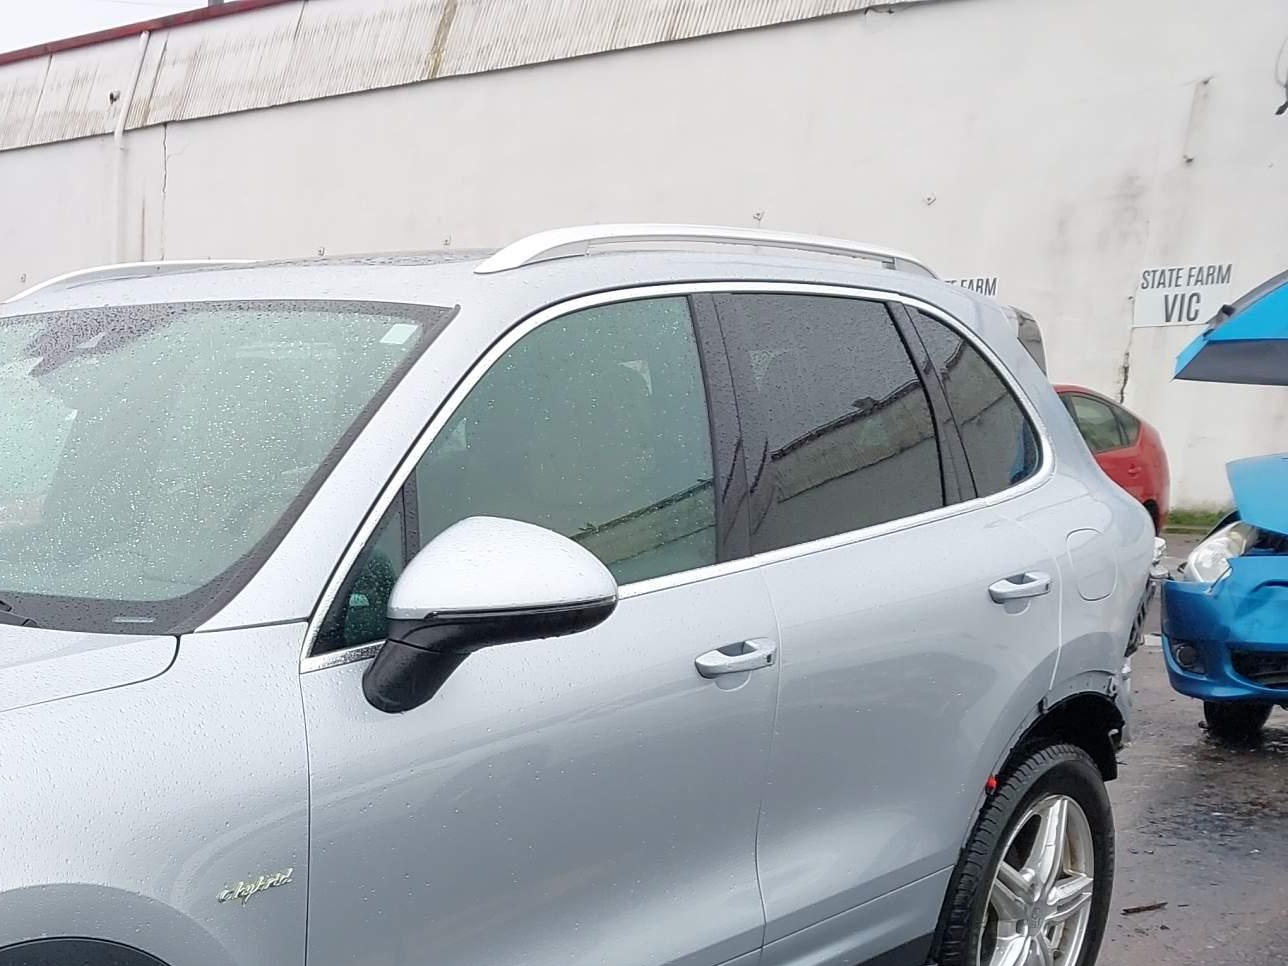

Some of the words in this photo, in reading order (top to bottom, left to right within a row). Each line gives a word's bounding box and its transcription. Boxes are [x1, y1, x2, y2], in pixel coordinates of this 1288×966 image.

[1141, 267, 1184, 290] STATE
[1187, 263, 1233, 287] FARM
[1164, 292, 1201, 323] VIC
